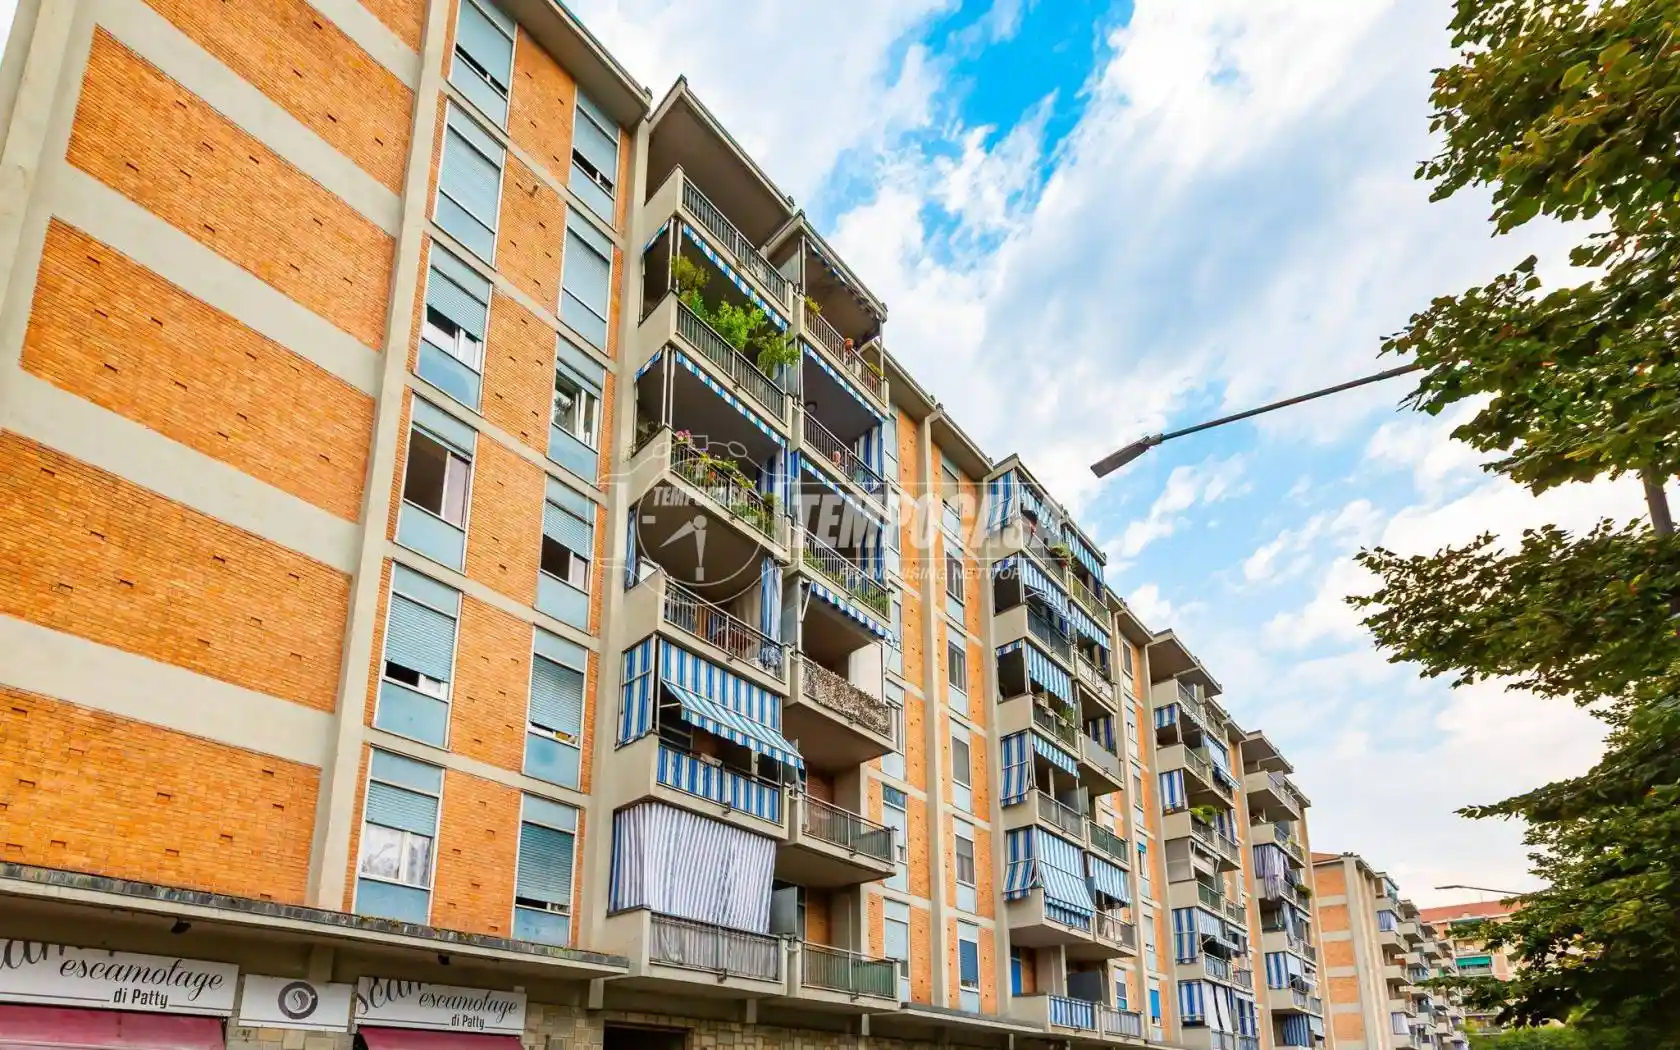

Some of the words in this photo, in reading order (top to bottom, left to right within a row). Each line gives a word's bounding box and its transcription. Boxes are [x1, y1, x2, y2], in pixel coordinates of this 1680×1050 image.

[59, 958, 223, 1001] escamotage
[113, 987, 127, 1003] di
[131, 989, 168, 1009] Patty
[418, 990, 518, 1024] escamotage
[451, 1014, 460, 1026] di
[462, 1015, 485, 1030] Patty
